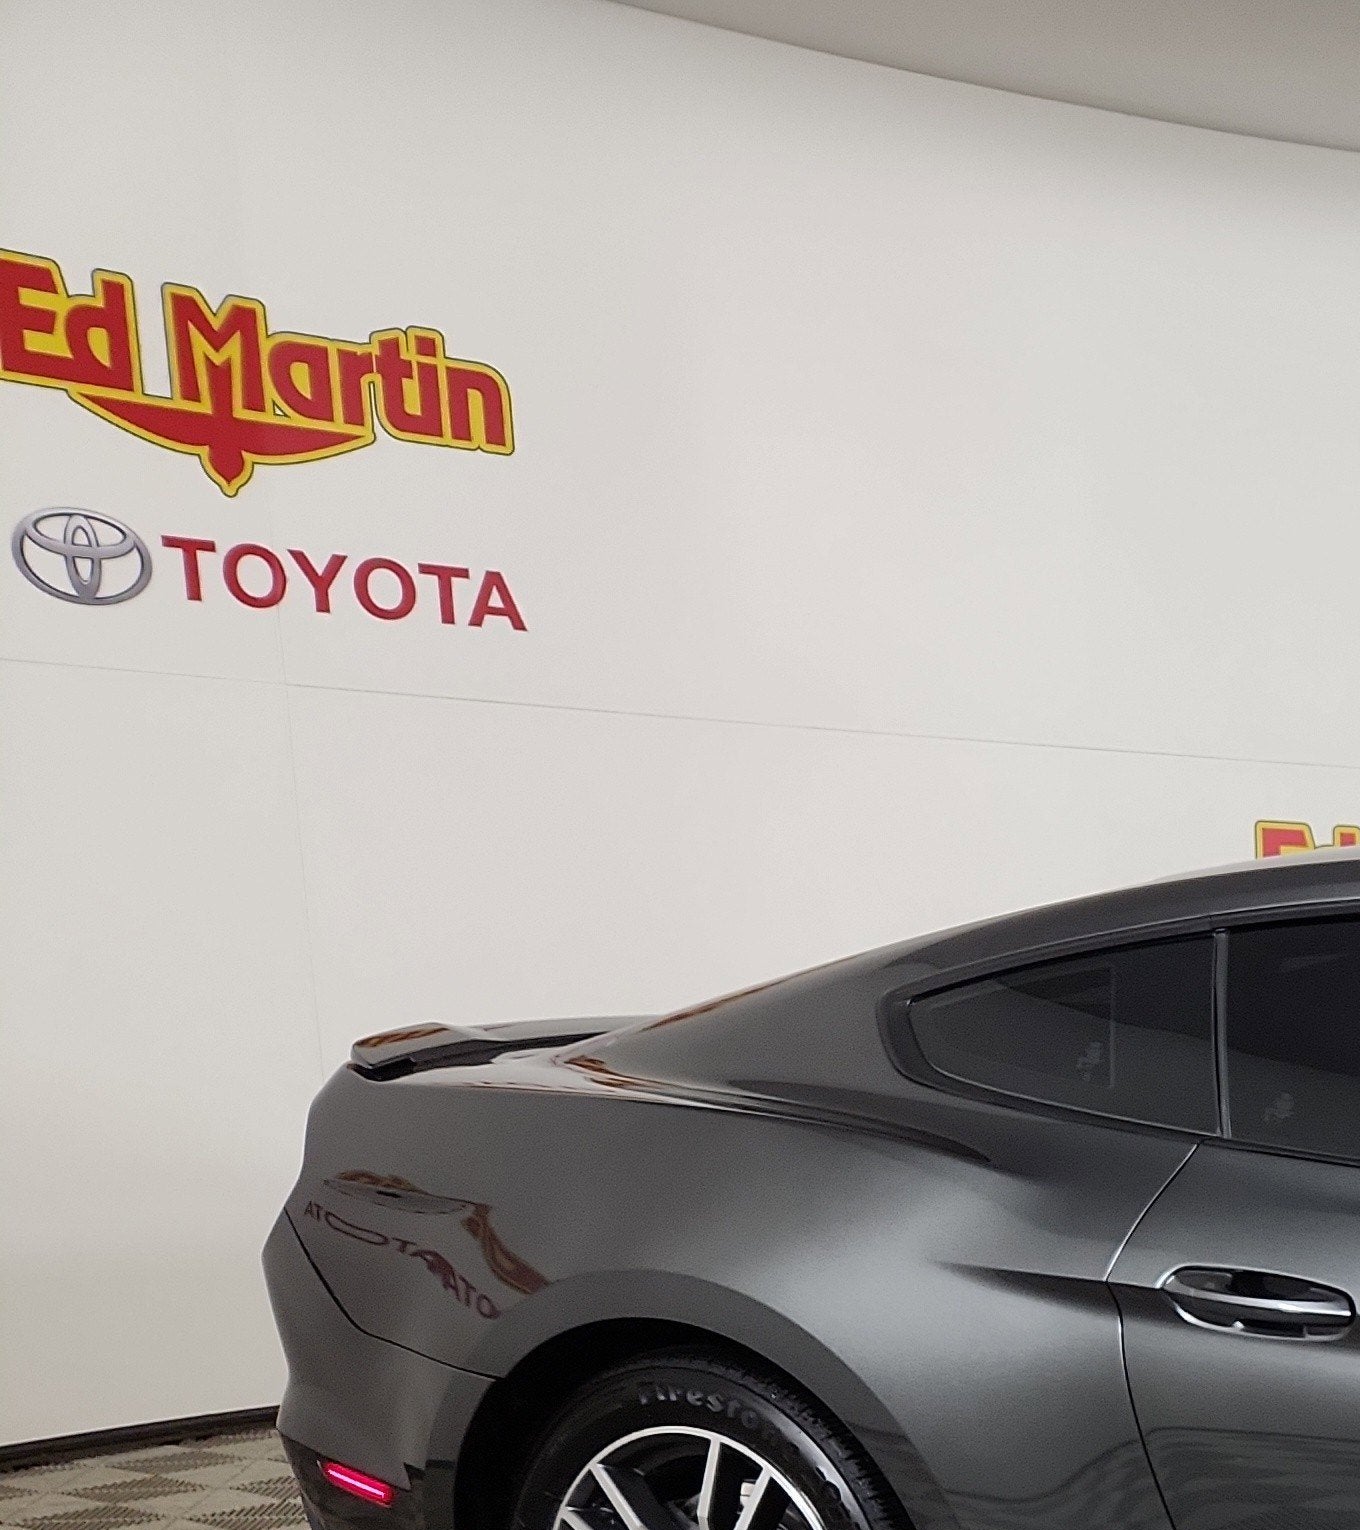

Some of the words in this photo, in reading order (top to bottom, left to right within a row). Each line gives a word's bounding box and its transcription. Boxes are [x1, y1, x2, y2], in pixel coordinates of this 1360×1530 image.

[0, 250, 139, 394] Ed
[162, 283, 514, 456] Martin
[161, 535, 528, 632] TOYOTA
